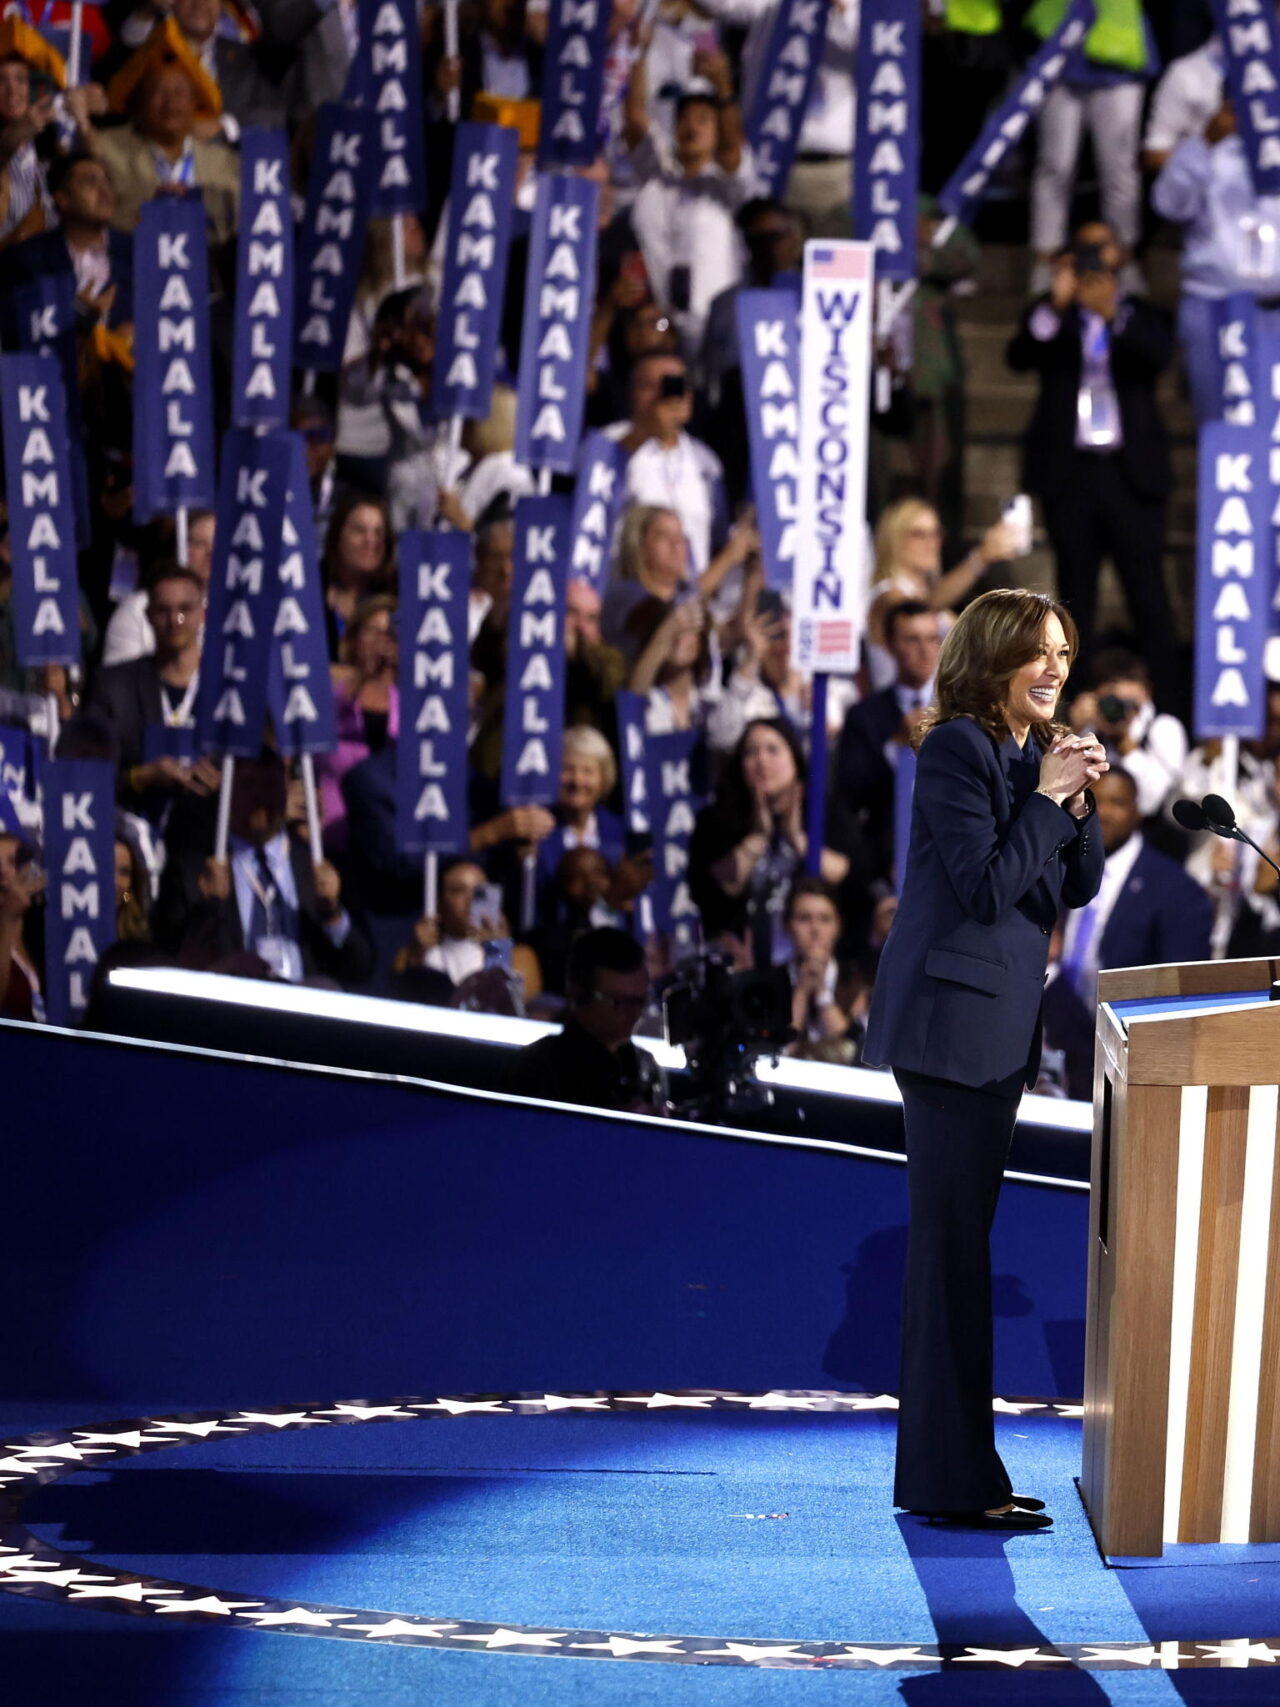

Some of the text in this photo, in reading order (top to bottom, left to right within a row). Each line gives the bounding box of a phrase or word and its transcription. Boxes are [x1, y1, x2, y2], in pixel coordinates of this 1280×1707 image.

[369, 2, 411, 190] AMALA
[552, 0, 598, 142] MALA
[867, 20, 908, 253] KAMALA
[158, 232, 198, 478] KAMALA
[244, 158, 284, 399] KAMALA
[301, 132, 362, 347] KAMALA
[444, 153, 501, 390] KAMALA
[531, 205, 582, 442] KAMALA
[813, 288, 860, 609] WISCONSIN
[1219, 319, 1257, 427] KAM
[18, 384, 66, 637] KAMALA
[213, 467, 270, 725] KAMALA
[573, 460, 616, 578] KAM
[1210, 452, 1255, 708] KAMALA
[413, 562, 455, 823] KAMALA
[514, 525, 558, 776] KAMALA
[60, 791, 100, 1009] KAMAL
